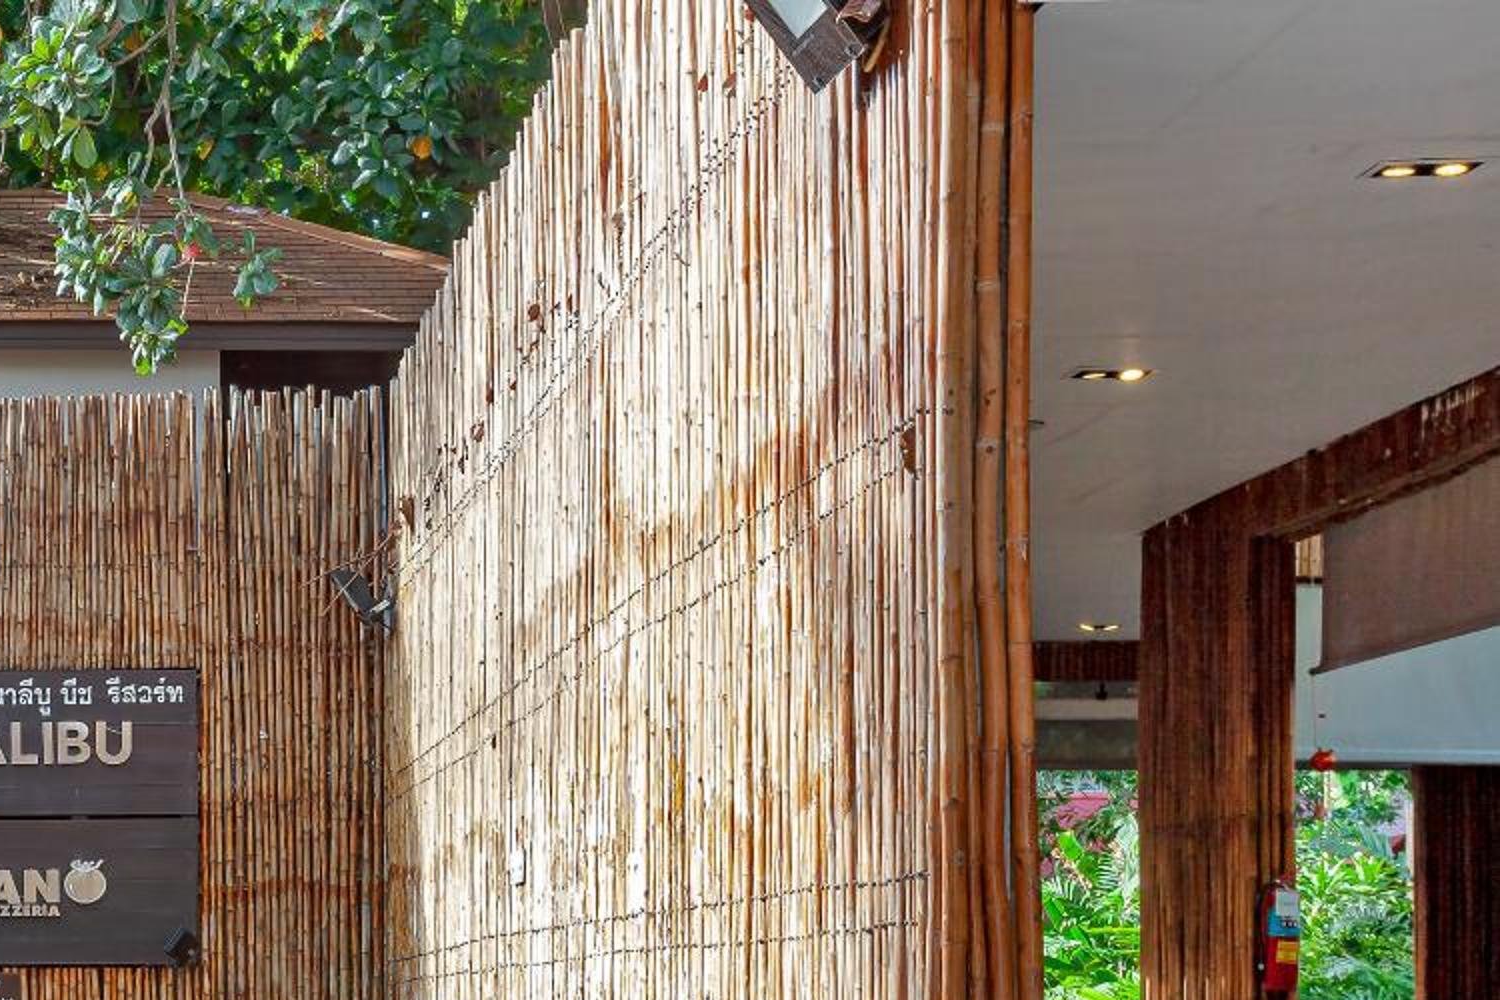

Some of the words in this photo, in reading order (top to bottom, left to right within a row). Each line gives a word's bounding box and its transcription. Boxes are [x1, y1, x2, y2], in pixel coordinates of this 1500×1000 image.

[60, 677, 93, 705] บีช
[105, 676, 184, 704] รีสอร์ท
